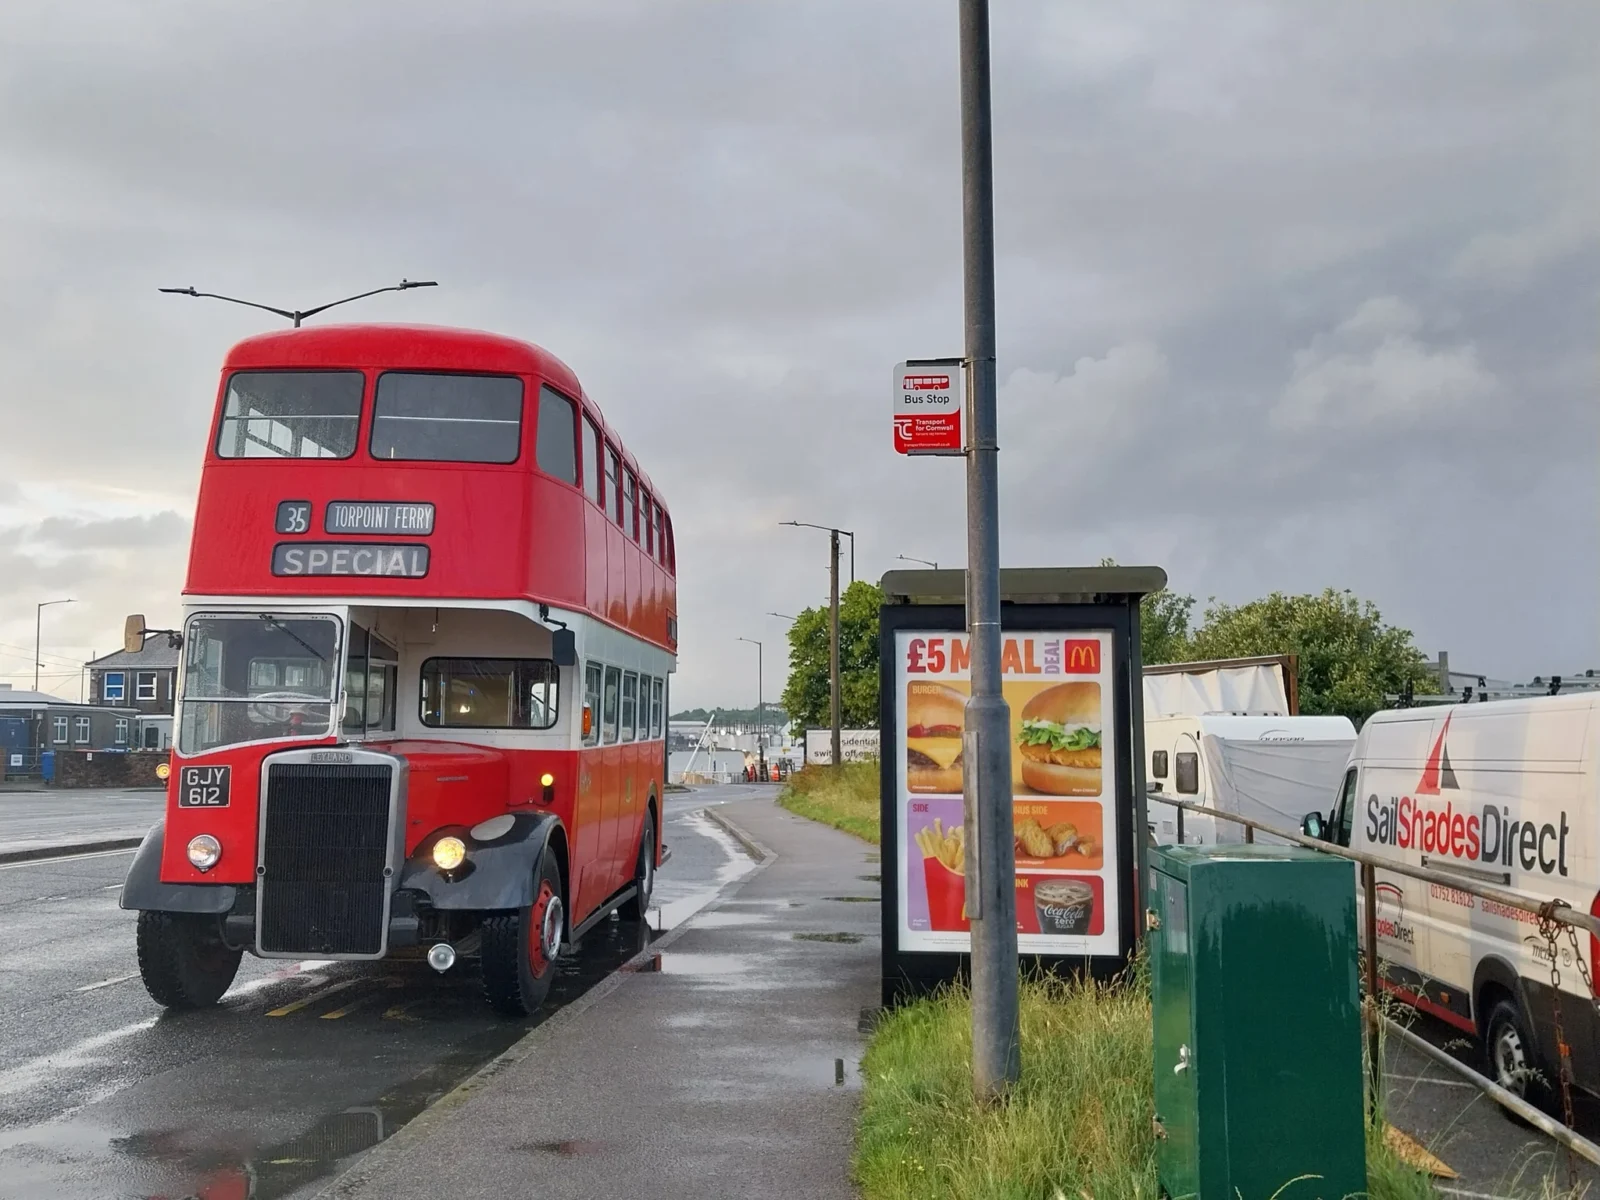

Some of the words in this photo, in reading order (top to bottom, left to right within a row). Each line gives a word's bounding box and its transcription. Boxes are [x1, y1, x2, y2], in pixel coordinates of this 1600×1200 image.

[904, 395, 924, 404] Bus
[926, 394, 950, 405] Stop
[285, 507, 307, 532] 35
[335, 506, 390, 528] TORPOINT
[394, 507, 432, 529] FERRY
[282, 549, 426, 576] SPECIAL
[907, 638, 946, 673] £5
[950, 638, 1042, 674] MAL
[1044, 639, 1060, 675] DEAL
[912, 685, 941, 695] BURGER
[311, 752, 351, 762] LEYLAND
[187, 768, 225, 786] GJY
[189, 787, 220, 805] 612
[912, 803, 929, 813] SIDE
[1031, 805, 1048, 815] SIDE
[1366, 793, 1570, 877] SailShadesDirect
